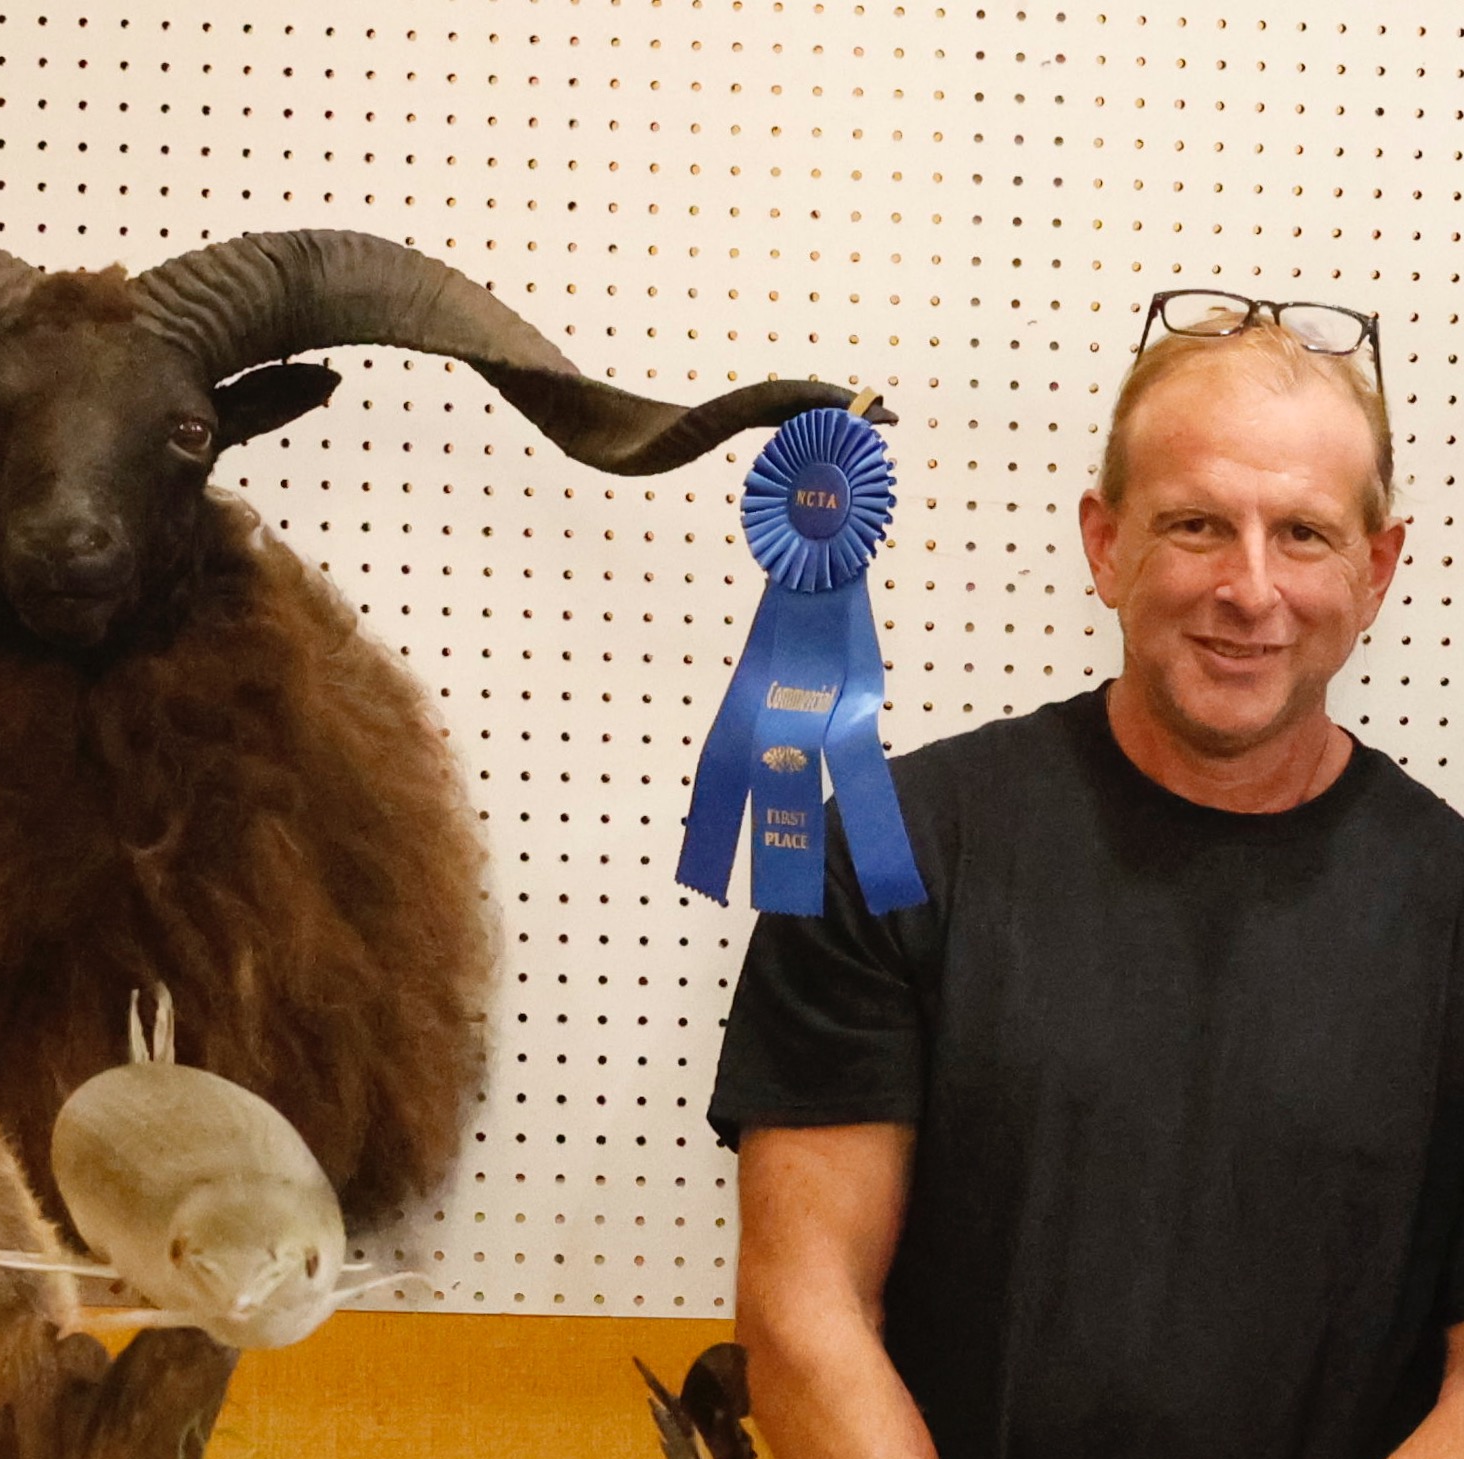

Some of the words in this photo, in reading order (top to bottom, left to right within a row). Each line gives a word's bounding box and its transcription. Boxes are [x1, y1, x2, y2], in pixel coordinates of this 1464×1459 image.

[795, 489, 838, 510] NCTA
[766, 680, 838, 714] Commercial
[767, 808, 807, 827] FIRST
[764, 832, 808, 850] PLACE
